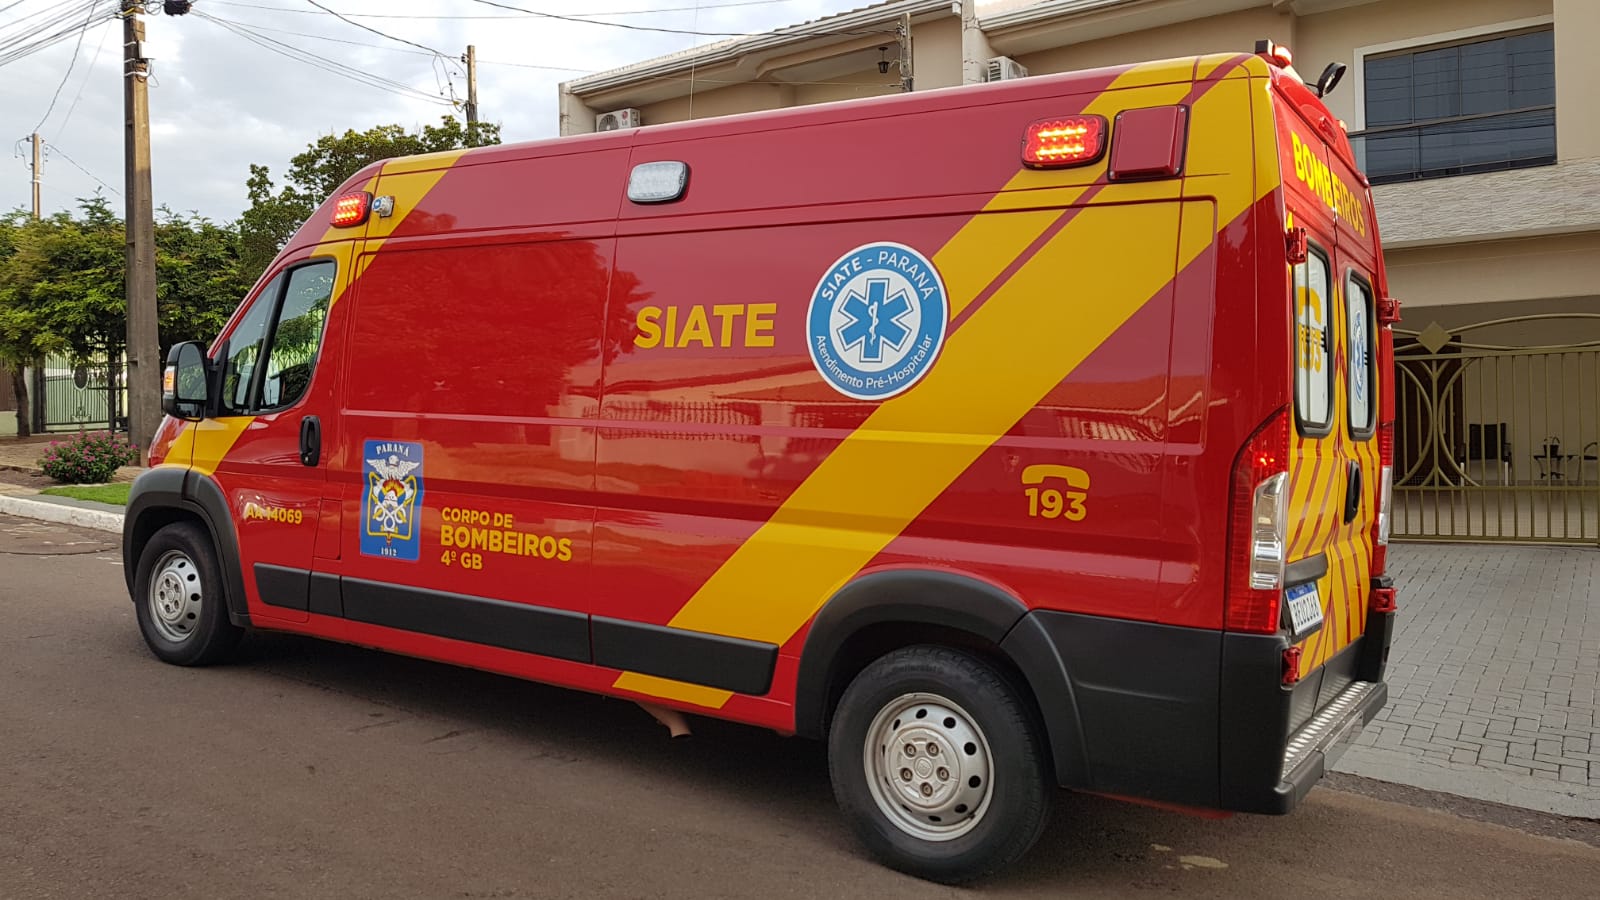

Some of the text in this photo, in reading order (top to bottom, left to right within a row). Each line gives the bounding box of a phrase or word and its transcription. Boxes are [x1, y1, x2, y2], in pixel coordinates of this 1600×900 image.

[1291, 129, 1366, 238] BOMBEIROS
[821, 257, 863, 301] SIATE
[878, 251, 938, 300] PARANÁ
[633, 303, 777, 349] SIATE
[816, 333, 933, 389] Atendimento Pré-Hospitalar
[441, 506, 513, 529] CORPO DE
[1024, 487, 1087, 521] 193
[440, 524, 573, 562] BOMBEIROS
[460, 553, 483, 570] GB
